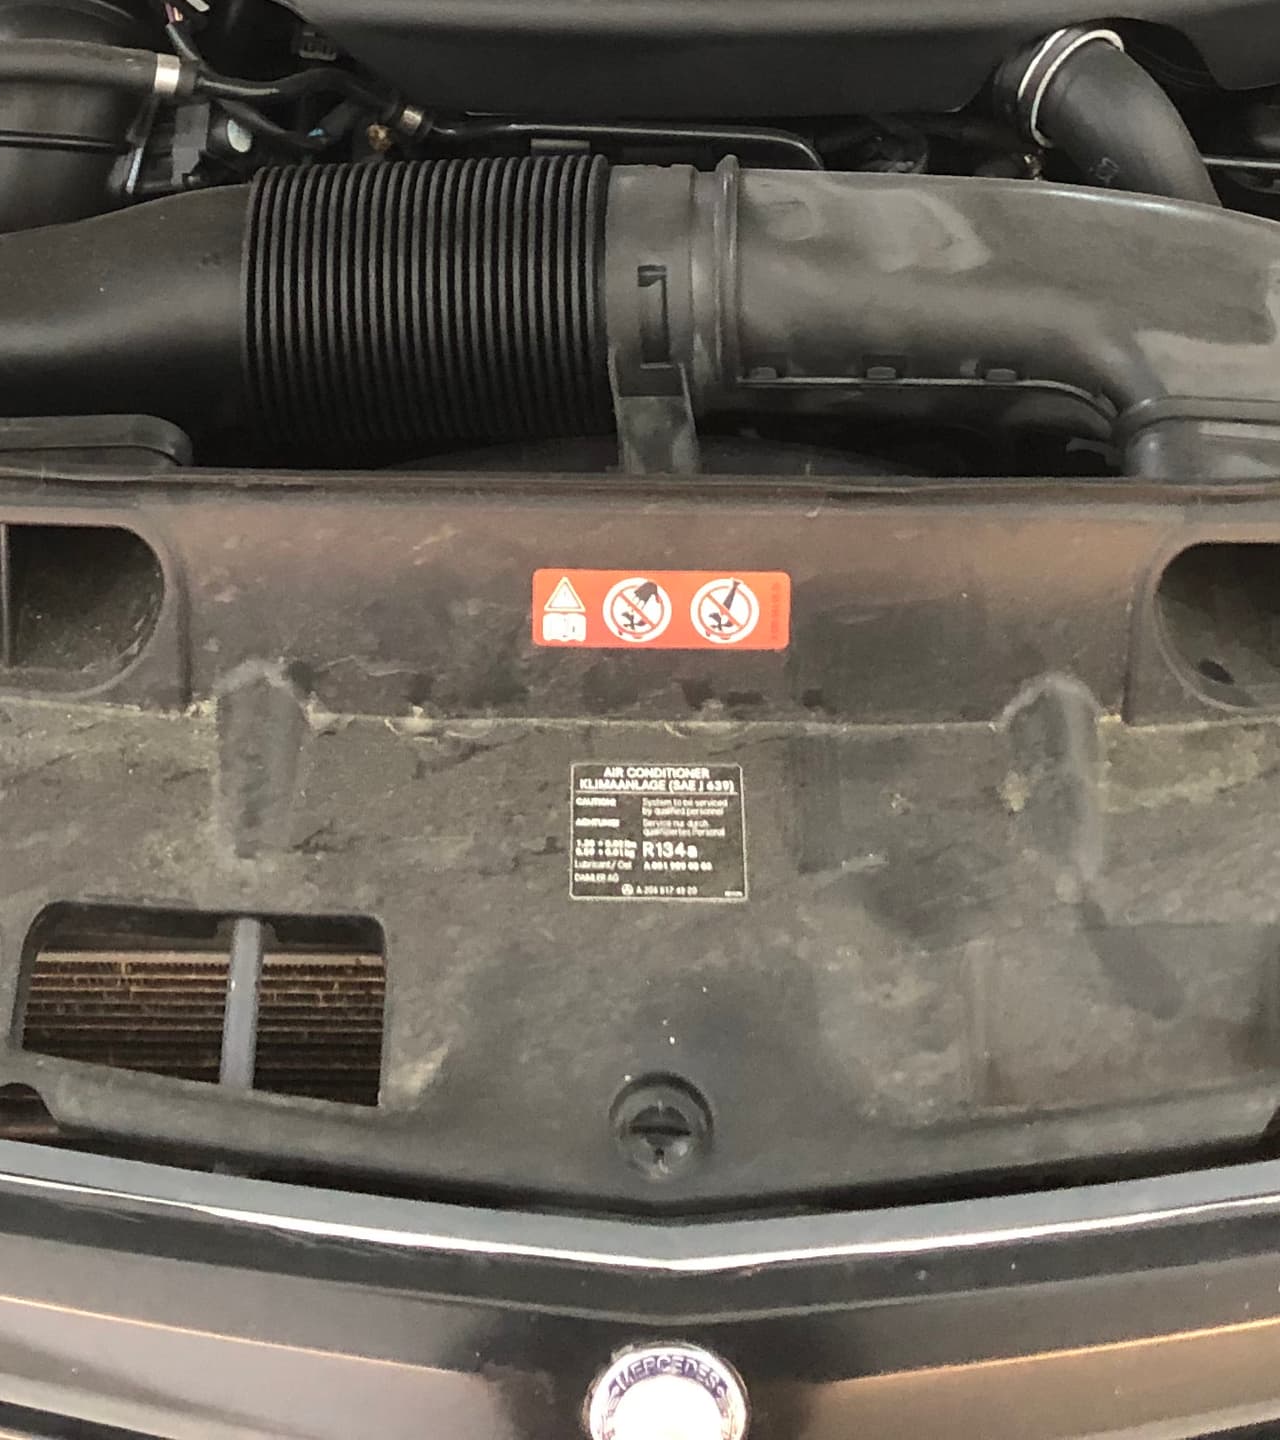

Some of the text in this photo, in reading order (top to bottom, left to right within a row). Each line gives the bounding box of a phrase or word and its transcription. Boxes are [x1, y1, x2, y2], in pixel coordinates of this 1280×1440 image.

[603, 767, 710, 779] AIR CONDITIONER
[579, 779, 734, 792] KLIMAANLAGE (SAE J 639)
[642, 798, 672, 809] System
[673, 798, 682, 807] to
[695, 798, 728, 808] serviced
[642, 807, 652, 817] by
[654, 807, 685, 817] qualified
[642, 819, 671, 828] Service
[642, 840, 698, 858] R134a
[643, 861, 650, 871] A
[636, 885, 643, 895] A
[615, 1355, 721, 1391] MERCEDES
